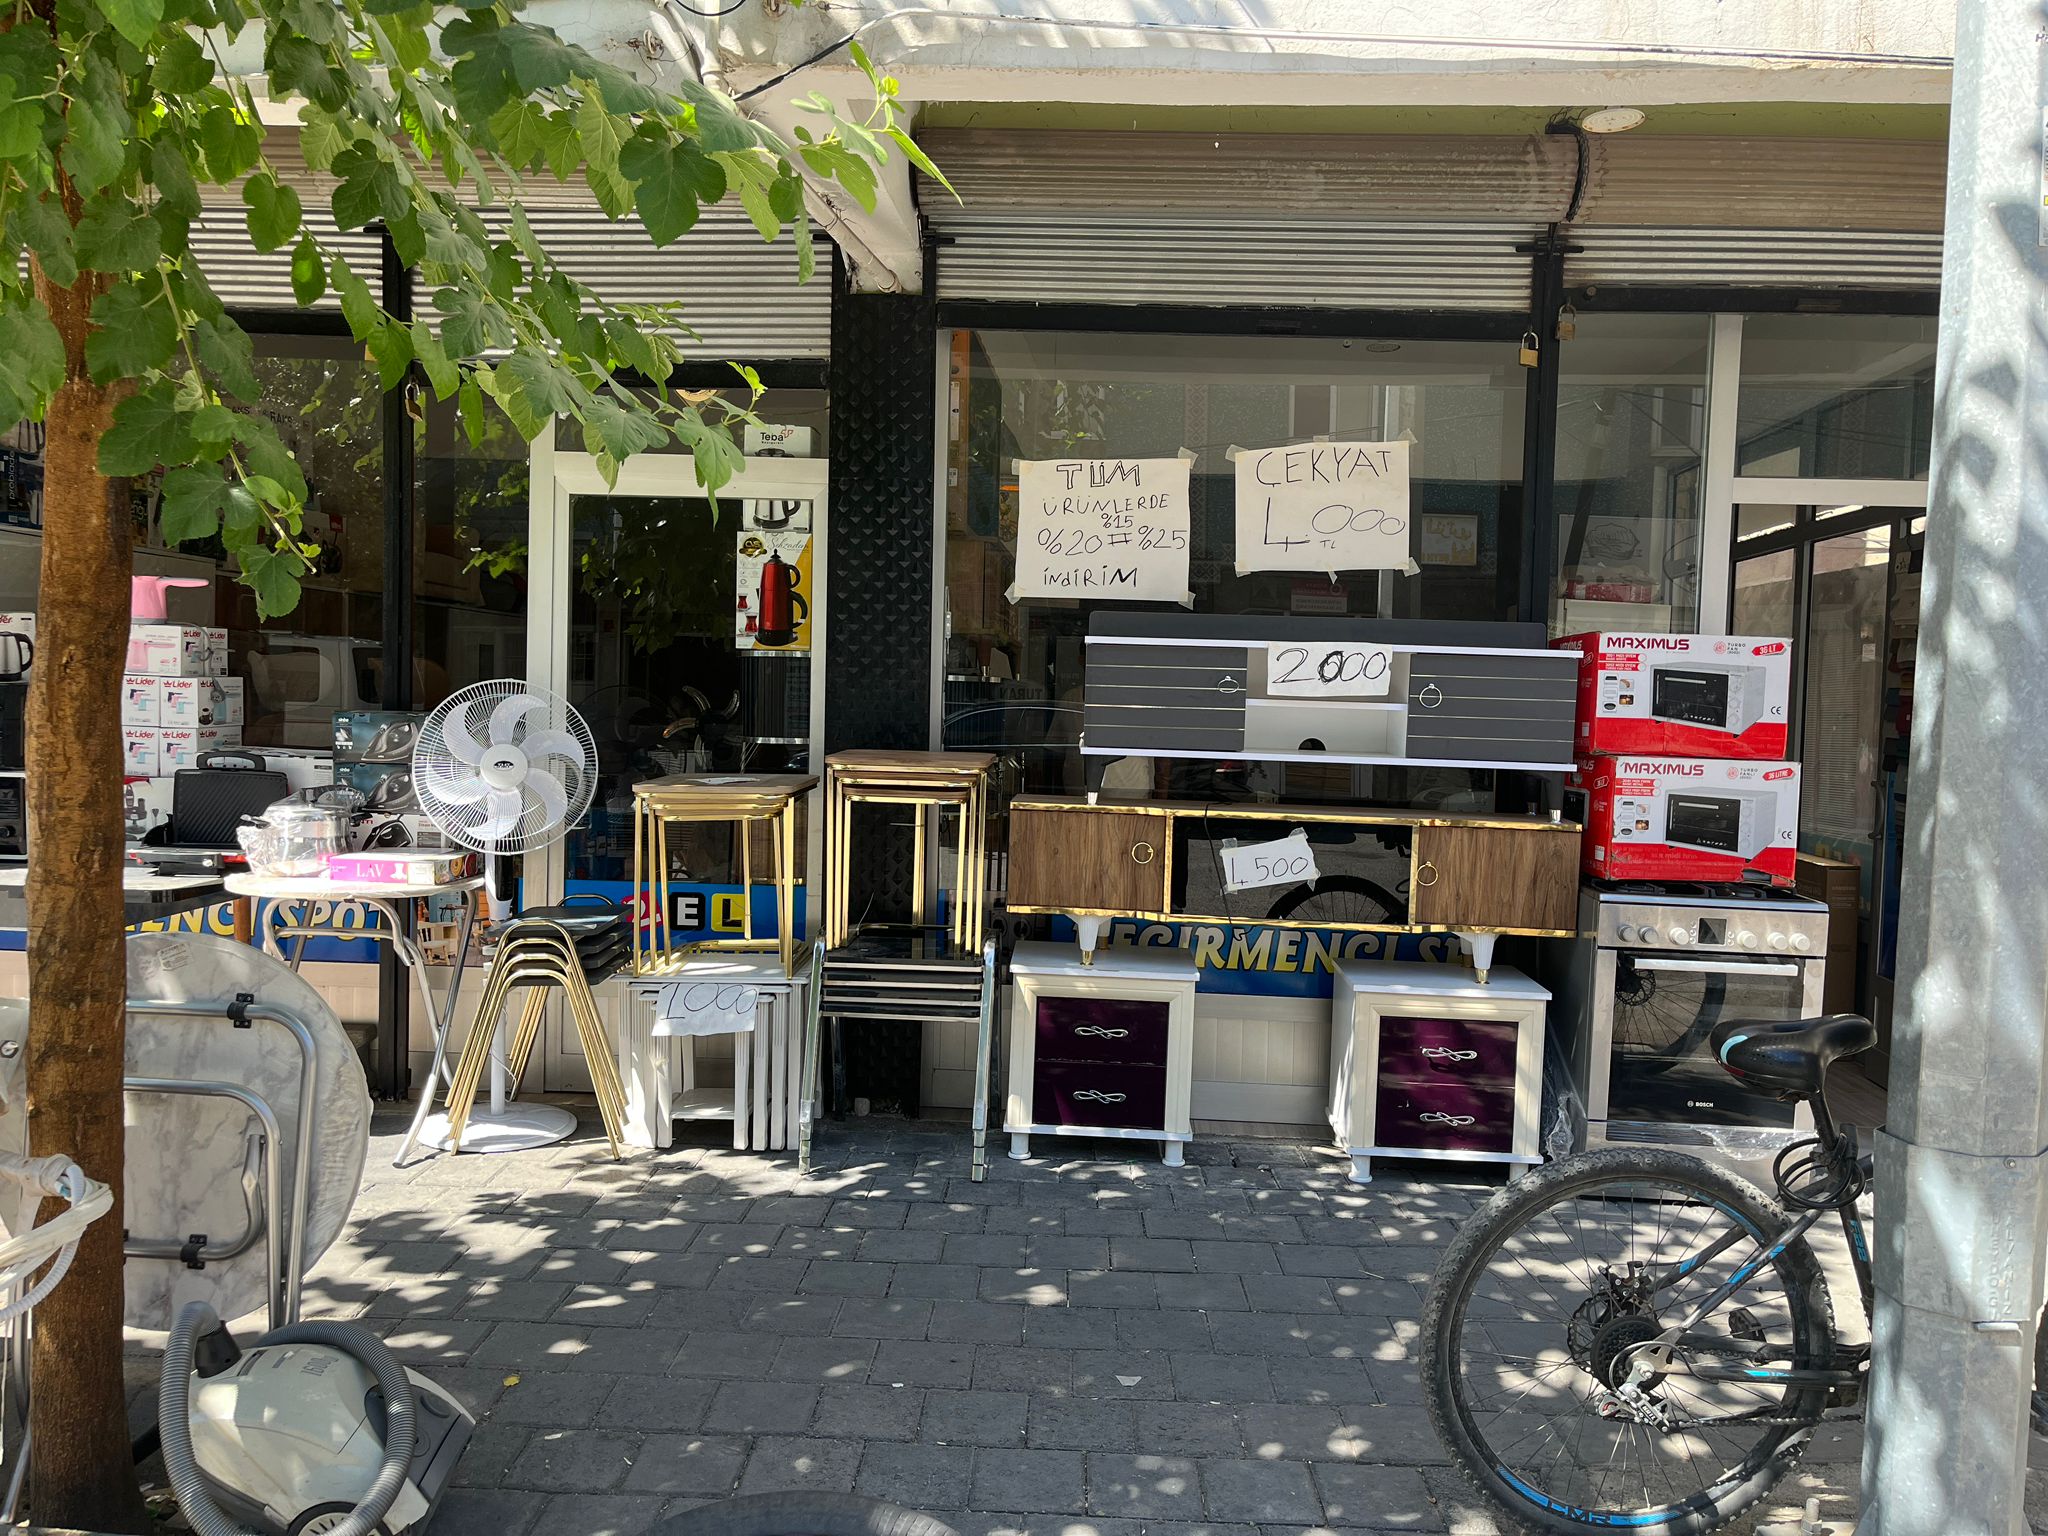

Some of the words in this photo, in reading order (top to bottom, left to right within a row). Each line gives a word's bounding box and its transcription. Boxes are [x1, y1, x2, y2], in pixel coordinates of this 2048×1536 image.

[760, 432, 784, 442] Teba
[1256, 447, 1391, 488] ÇEKYAT
[1056, 460, 1141, 490] TÜM
[1042, 493, 1170, 516] ÜRÜNLERDE
[1100, 512, 1134, 529] %15
[1138, 525, 1188, 550] %25
[1606, 637, 1690, 650] MAXIMUS
[1760, 646, 1768, 655] 36
[1768, 644, 1777, 653] LT
[135, 677, 155, 686] Lider
[172, 680, 192, 689] Lider
[134, 730, 154, 739] Lider
[171, 731, 191, 739] Lider
[1624, 762, 1704, 776] MAXIMUS
[660, 982, 758, 1020] 1000
